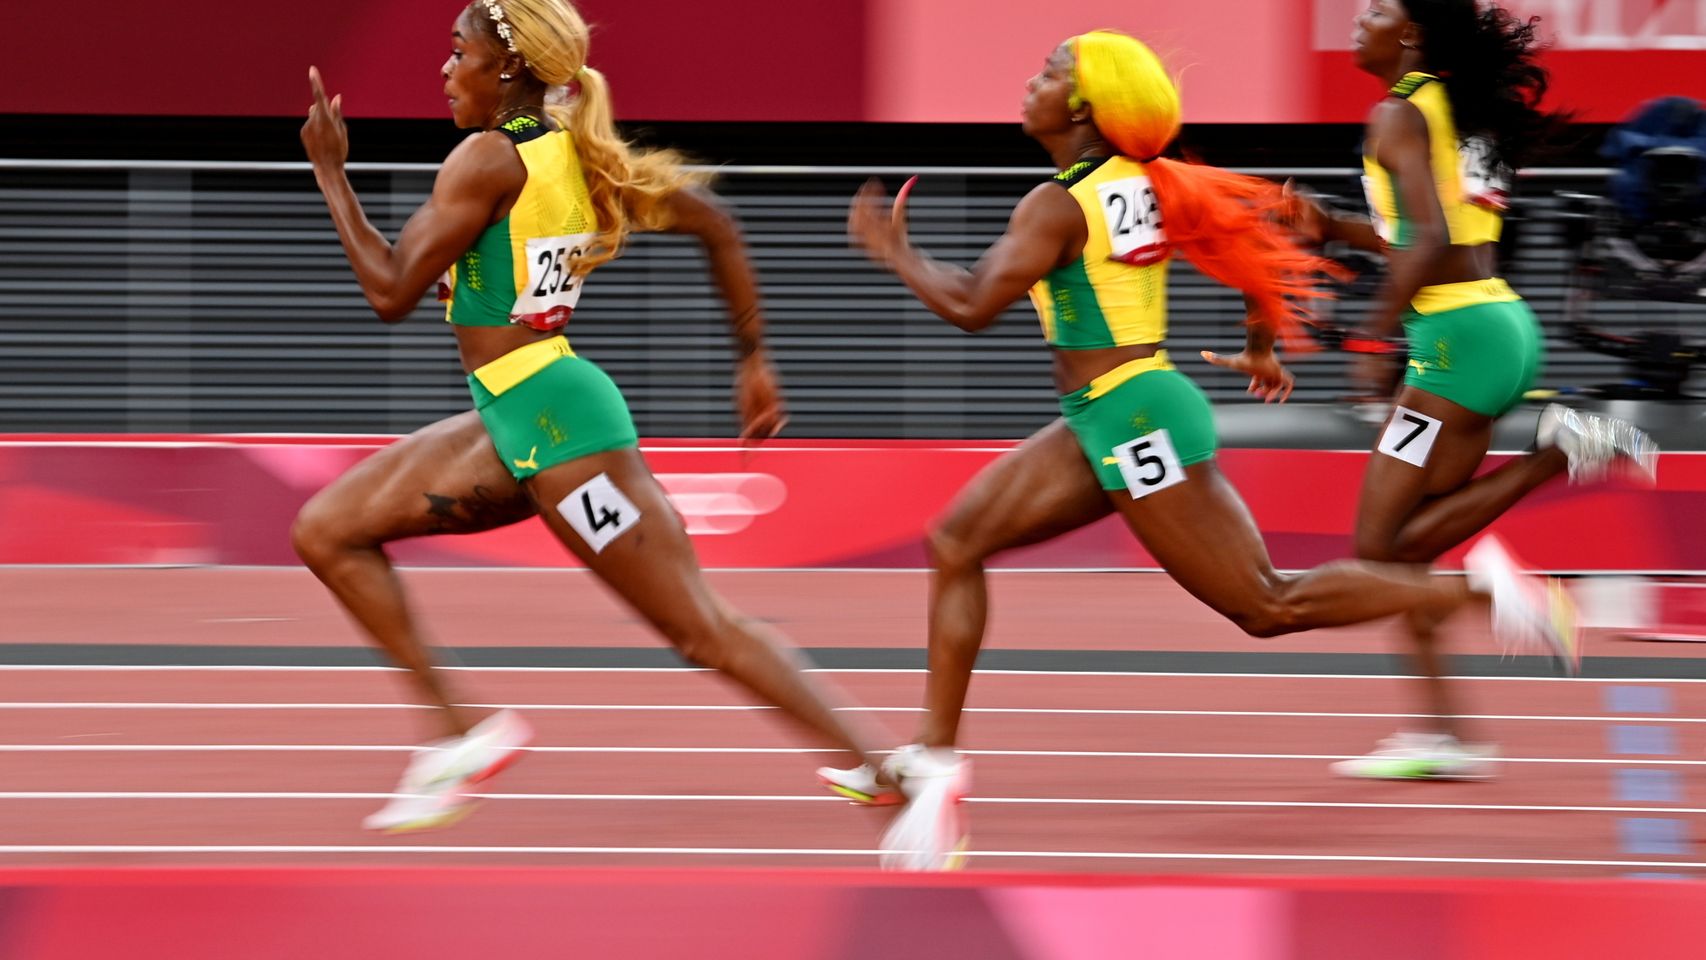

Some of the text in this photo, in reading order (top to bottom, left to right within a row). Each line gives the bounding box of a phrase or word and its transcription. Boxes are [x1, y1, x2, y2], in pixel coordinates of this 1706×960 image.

[1392, 413, 1430, 452] 7
[1128, 441, 1166, 486] 5
[581, 490, 620, 534] 4
